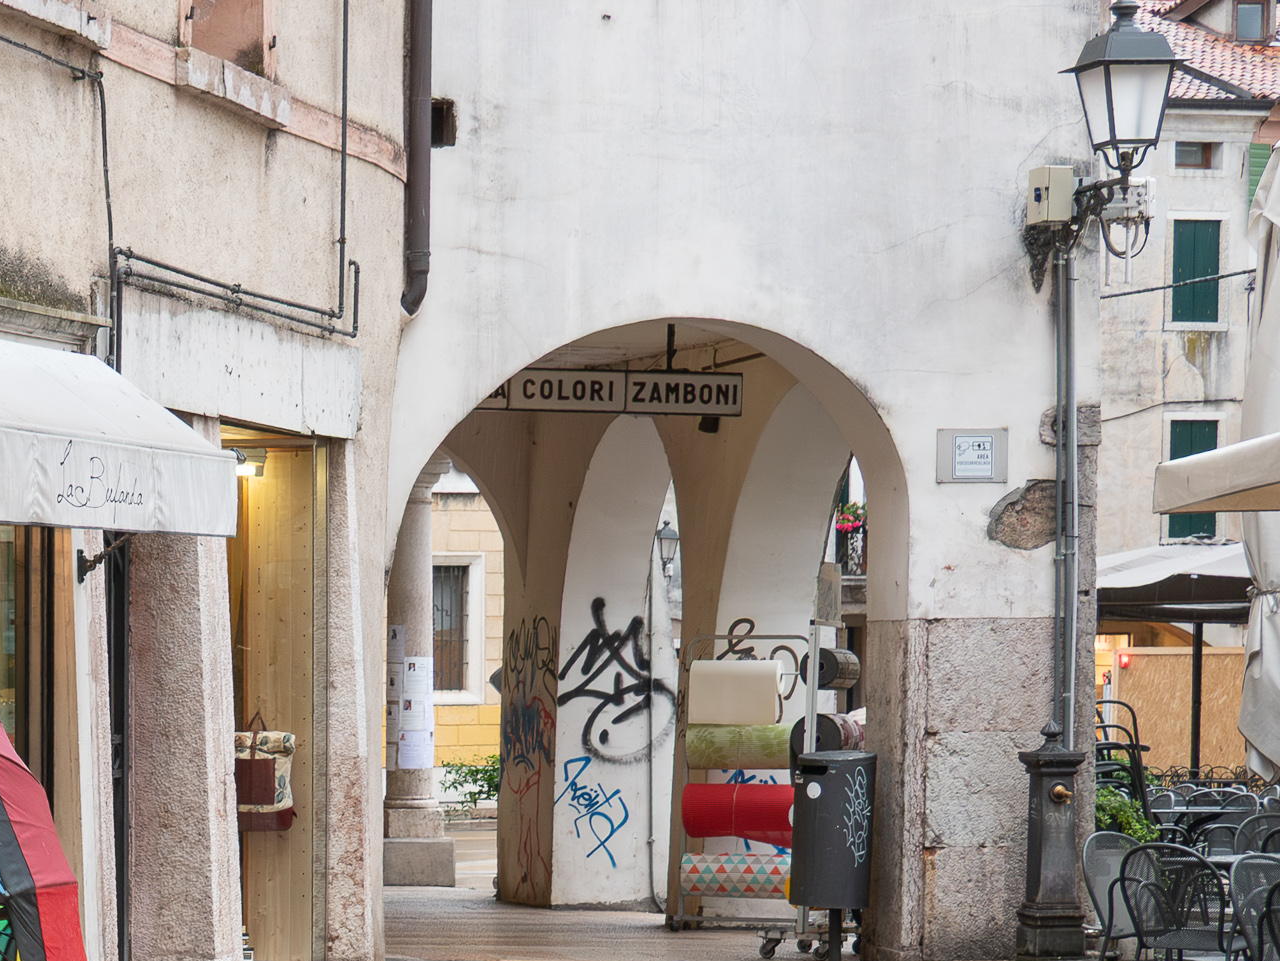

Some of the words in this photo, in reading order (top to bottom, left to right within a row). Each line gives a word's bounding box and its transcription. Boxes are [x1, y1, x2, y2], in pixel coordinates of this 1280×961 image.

[487, 382, 507, 400] A
[522, 378, 615, 402] COLORI
[631, 381, 738, 406] ZAMBONI
[75, 456, 144, 525] Bufanda
